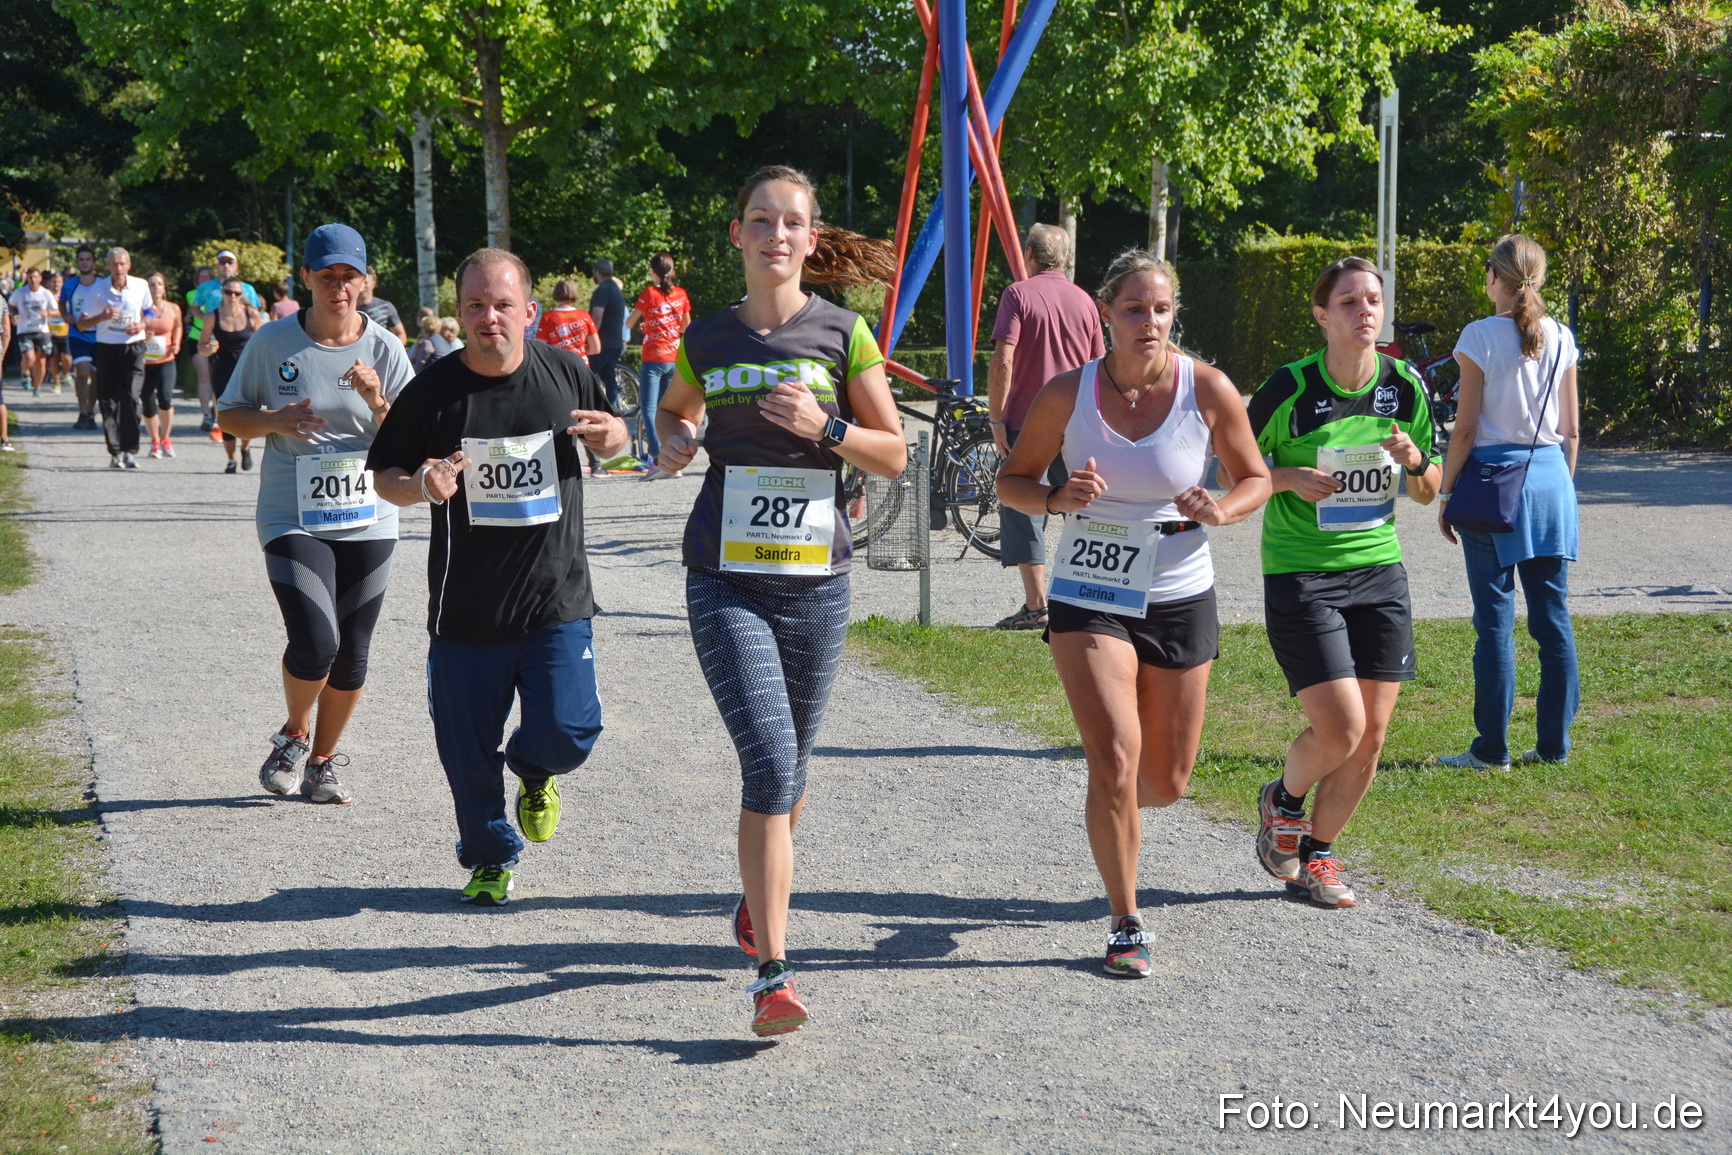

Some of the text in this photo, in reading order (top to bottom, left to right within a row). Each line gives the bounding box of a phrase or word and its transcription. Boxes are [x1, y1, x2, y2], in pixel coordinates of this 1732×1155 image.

[702, 360, 834, 395] BOCK
[705, 393, 735, 410] nspired
[738, 394, 752, 405] by
[489, 442, 528, 457] BOCK
[1345, 451, 1385, 463] BOCK
[321, 460, 357, 470] BOCK
[477, 458, 544, 490] 3023
[757, 475, 806, 489] BOCK
[1332, 465, 1392, 494] 3003
[310, 473, 367, 499] 2014
[323, 511, 359, 522] Martina
[750, 495, 810, 528] 287
[1088, 521, 1129, 537] BOCK
[755, 546, 800, 561] Sandra
[1069, 538, 1140, 574] 2587
[1072, 571, 1121, 583] PARTL Neumarkt
[1079, 584, 1116, 602] Carina
